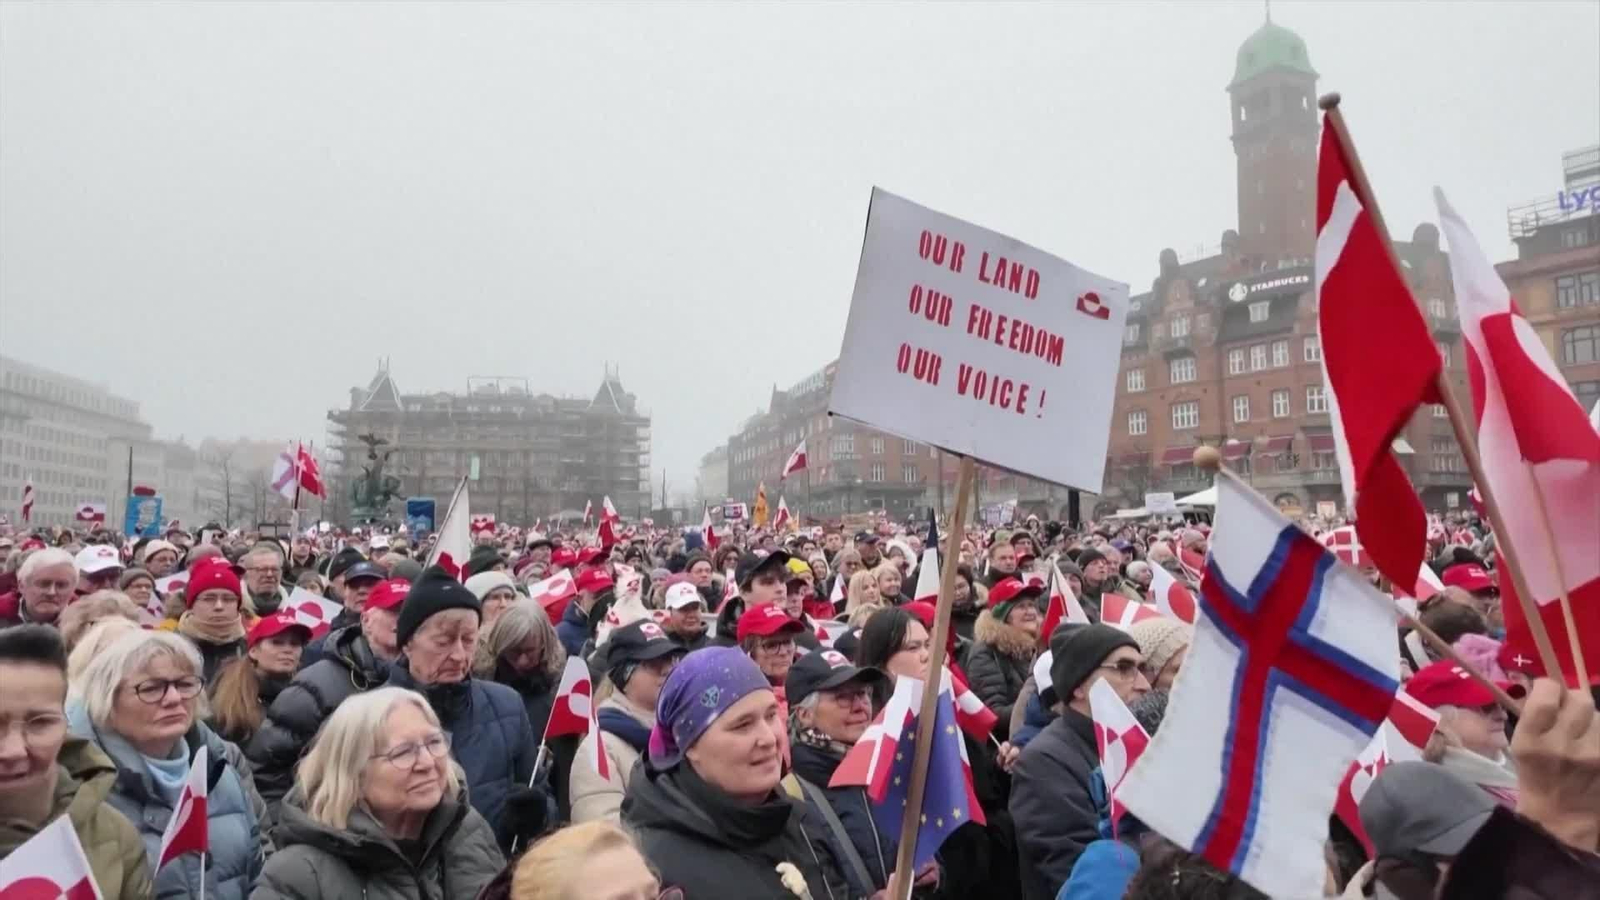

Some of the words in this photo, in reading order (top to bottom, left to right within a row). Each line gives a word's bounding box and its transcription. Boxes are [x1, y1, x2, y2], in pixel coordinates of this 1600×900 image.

[919, 230, 966, 273] OUR
[979, 252, 1041, 300] LAND
[1250, 275, 1309, 293] STARBUCKS
[909, 284, 953, 327] OUR
[966, 304, 1065, 367] FREEDOM
[896, 343, 943, 386] OUR
